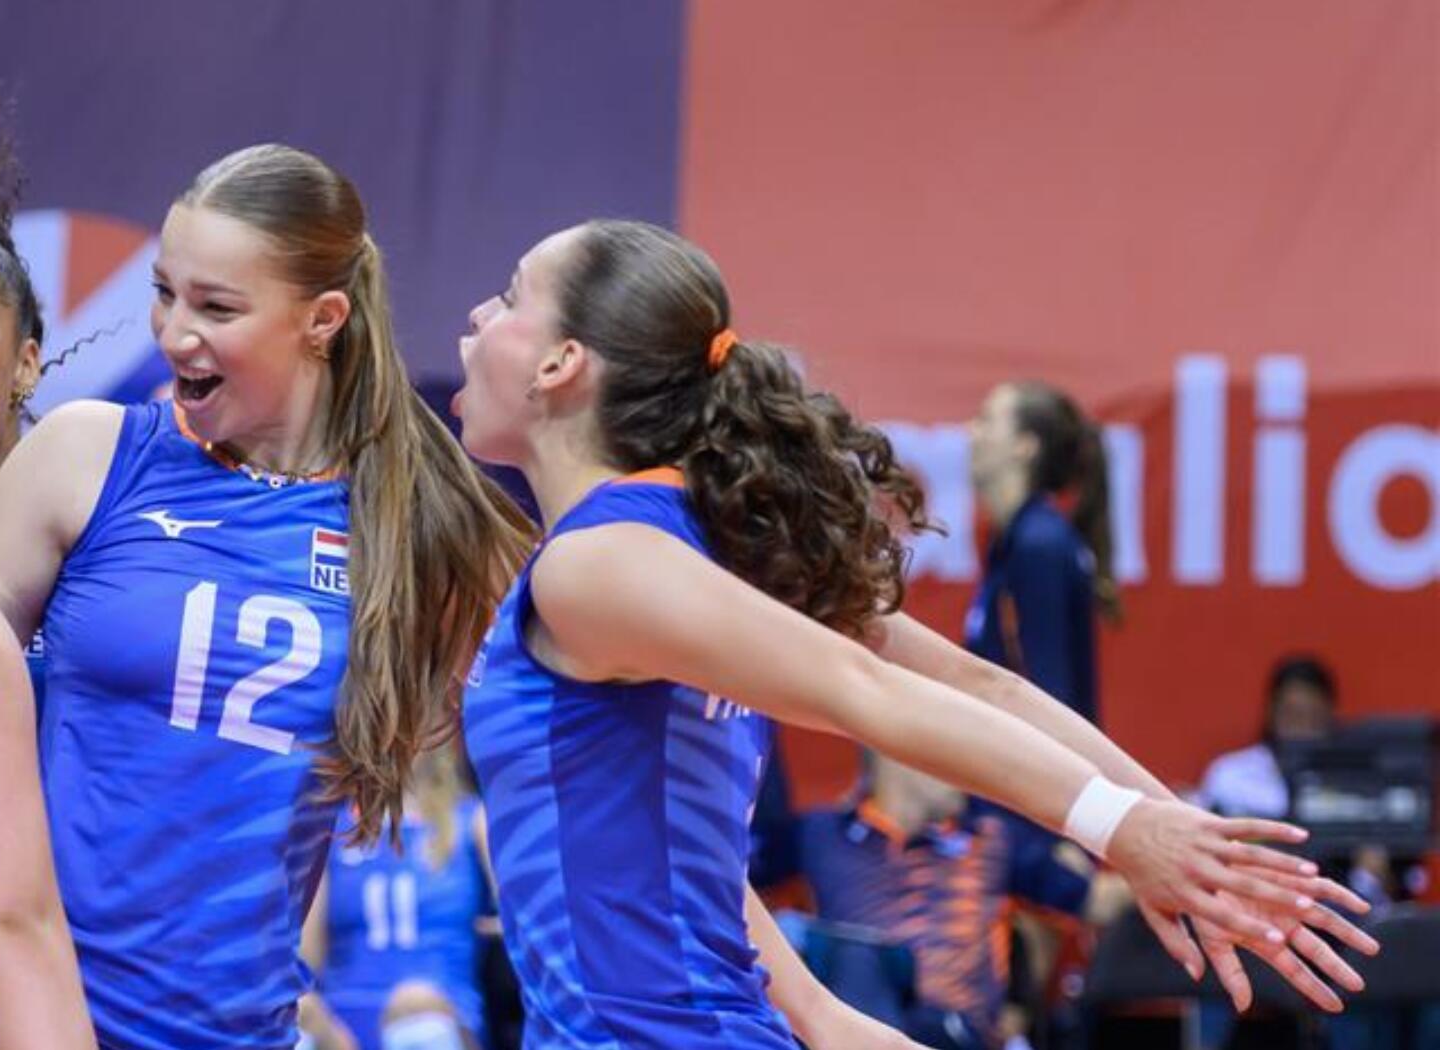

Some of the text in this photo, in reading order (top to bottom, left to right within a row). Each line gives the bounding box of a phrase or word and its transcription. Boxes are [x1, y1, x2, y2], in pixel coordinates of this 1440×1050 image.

[314, 565, 348, 592] NE
[169, 580, 323, 756] 12
[363, 872, 417, 951] 11
